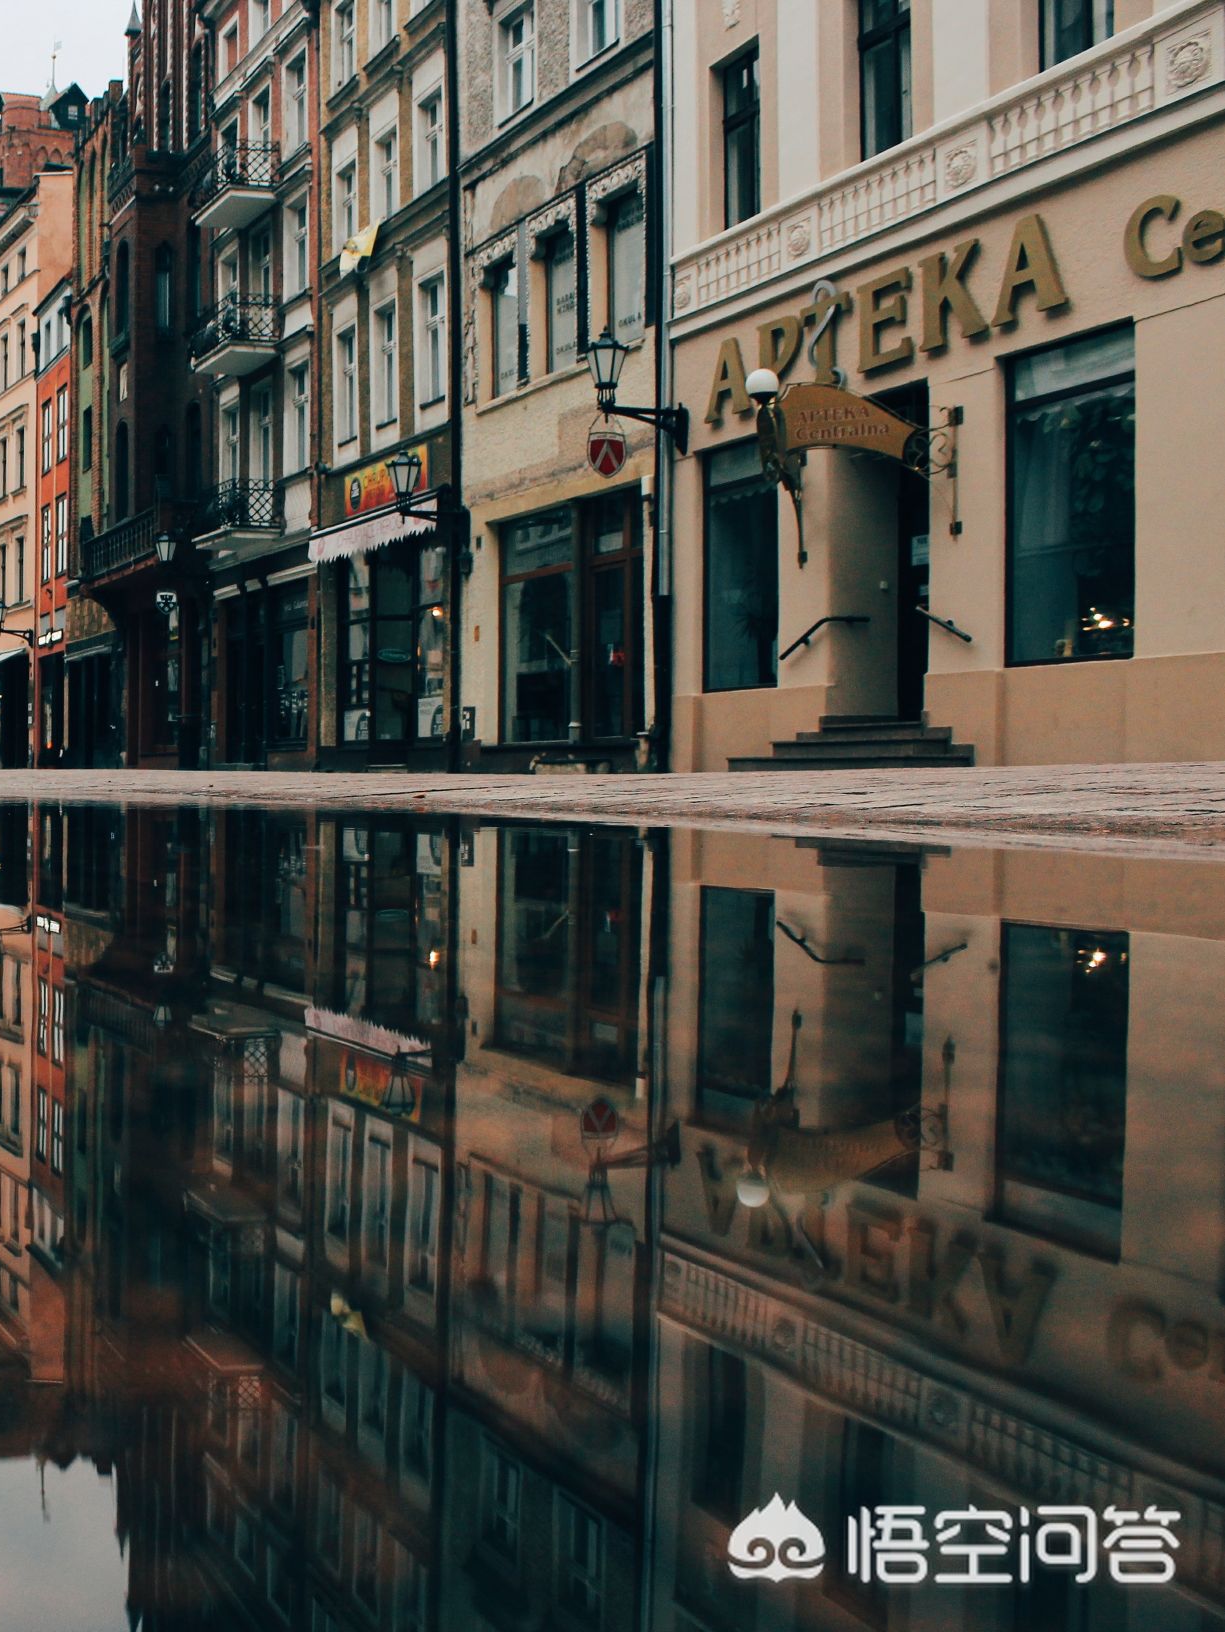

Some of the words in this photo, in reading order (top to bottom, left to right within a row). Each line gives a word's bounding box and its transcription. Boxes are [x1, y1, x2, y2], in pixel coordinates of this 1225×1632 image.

[703, 212, 1069, 424] APTEKA
[798, 405, 870, 422] APTEKA
[796, 423, 889, 440] Centralna
